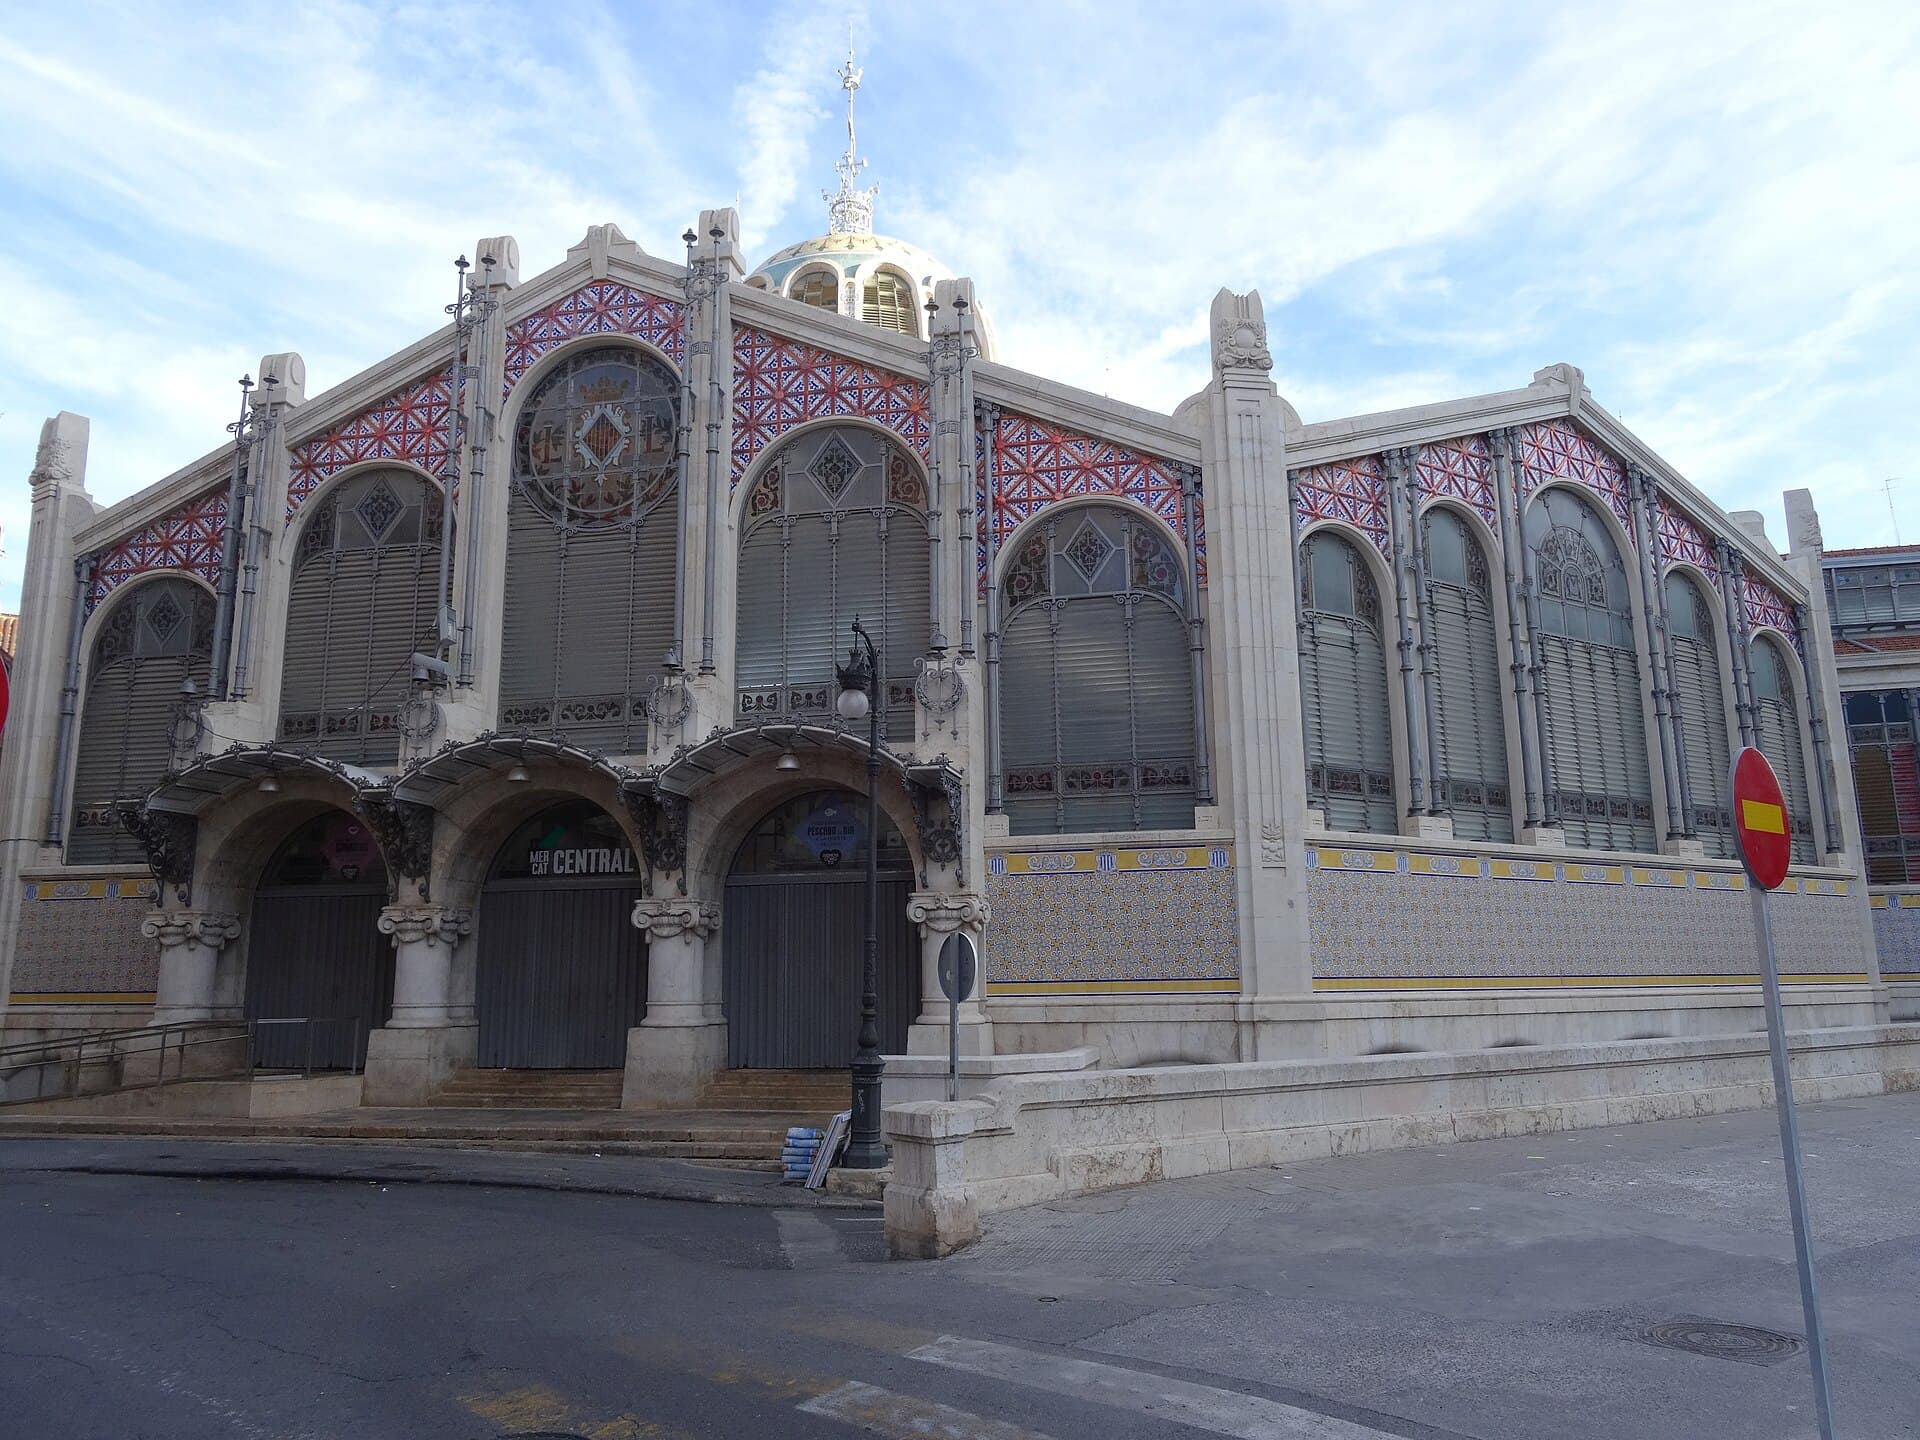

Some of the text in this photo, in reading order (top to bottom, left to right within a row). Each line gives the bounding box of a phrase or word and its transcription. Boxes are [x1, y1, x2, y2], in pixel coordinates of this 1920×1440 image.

[530, 851, 549, 862] MER
[553, 848, 634, 873] CENTRAL
[532, 863, 549, 875] CAT
